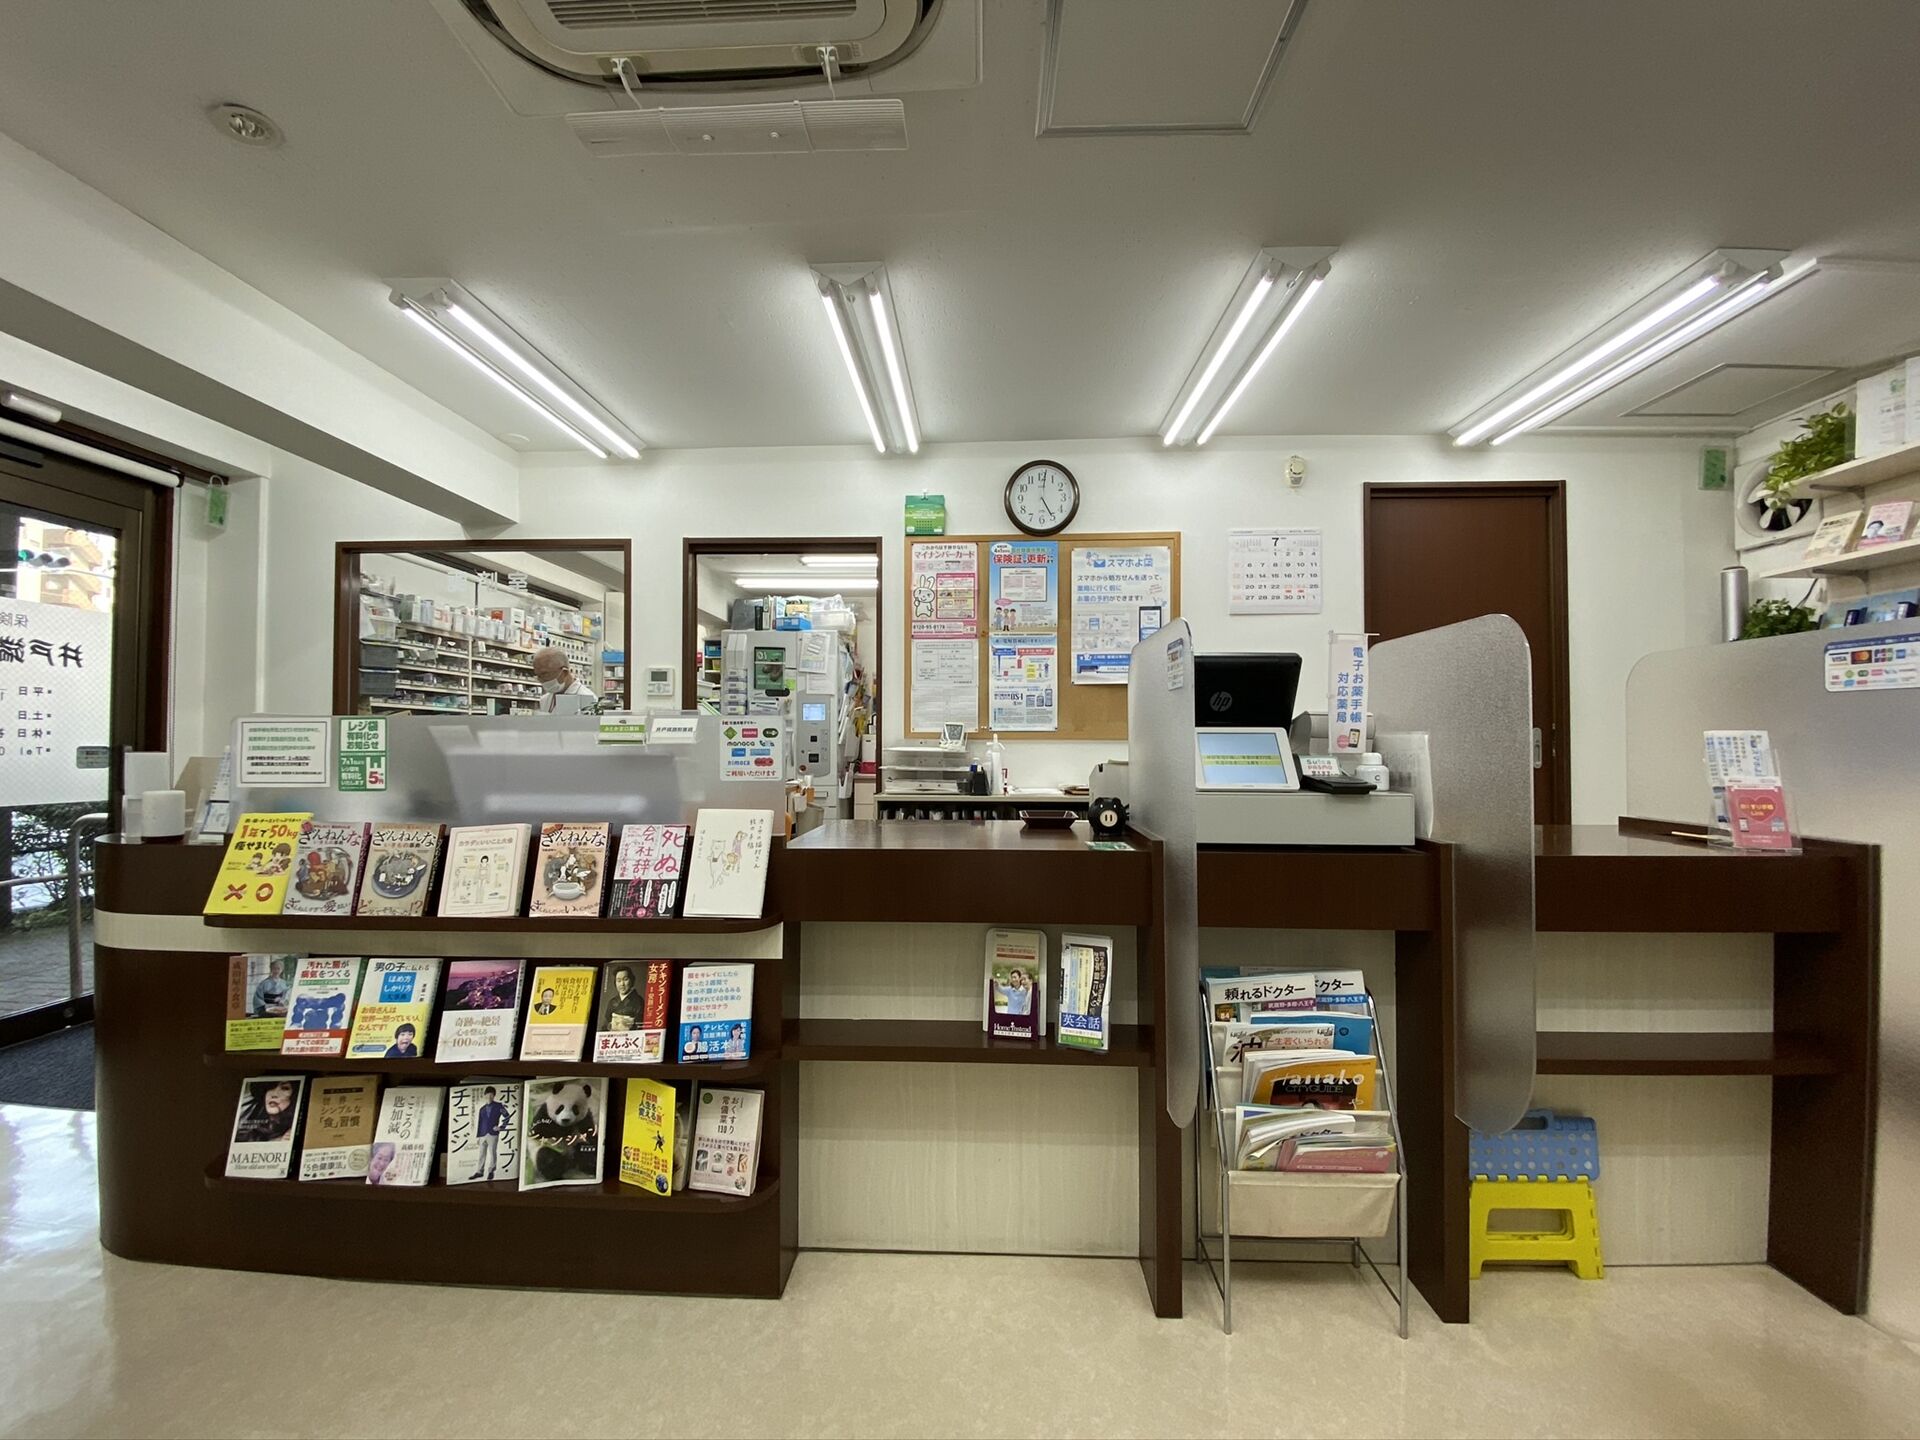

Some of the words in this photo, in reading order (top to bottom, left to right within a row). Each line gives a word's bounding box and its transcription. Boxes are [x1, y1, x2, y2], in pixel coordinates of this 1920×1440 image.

[1028, 476, 1034, 484] 11
[1020, 484, 1027, 492] 10
[1058, 482, 1063, 491] 2
[1017, 494, 1023, 503] 9
[1061, 493, 1066, 502] 3
[1020, 505, 1026, 514] 8
[1028, 513, 1034, 522] 7
[1039, 514, 1045, 524] 6
[1050, 512, 1056, 521] 5
[1272, 537, 1279, 546] 7
[1350, 647, 1364, 723] 電子お薬手帳
[1210, 691, 1232, 712] hp
[1336, 672, 1349, 723] 対応薬局
[348, 721, 378, 731] レジ袋
[347, 732, 379, 740] 有料化の
[347, 742, 379, 750] お知らせ
[299, 829, 362, 846] ざんねんな
[373, 830, 436, 847] ざんねんな
[542, 831, 606, 847] ざんねんな
[306, 960, 350, 969] 汚れた腸が
[374, 962, 429, 972] 男の子に伝わる
[301, 970, 350, 978] 病気をつくる
[648, 964, 659, 983] 女房
[656, 963, 668, 1027] チキンラーメンの
[1225, 984, 1306, 1000] 頼れるドクター
[456, 1015, 500, 1027] 奇跡の絶景
[1063, 1014, 1100, 1030] 英会話
[452, 1036, 497, 1047] 100の言葉
[601, 1038, 639, 1049] まんぷく
[1267, 1037, 1330, 1045] 一生若くいられる
[321, 1105, 360, 1115] シンプルな
[388, 1096, 406, 1134] 匙加減
[400, 1096, 415, 1139] こころの
[452, 1088, 470, 1153] チェンジ
[728, 1097, 740, 1135] おくすり
[230, 1152, 287, 1164] MAENORI
